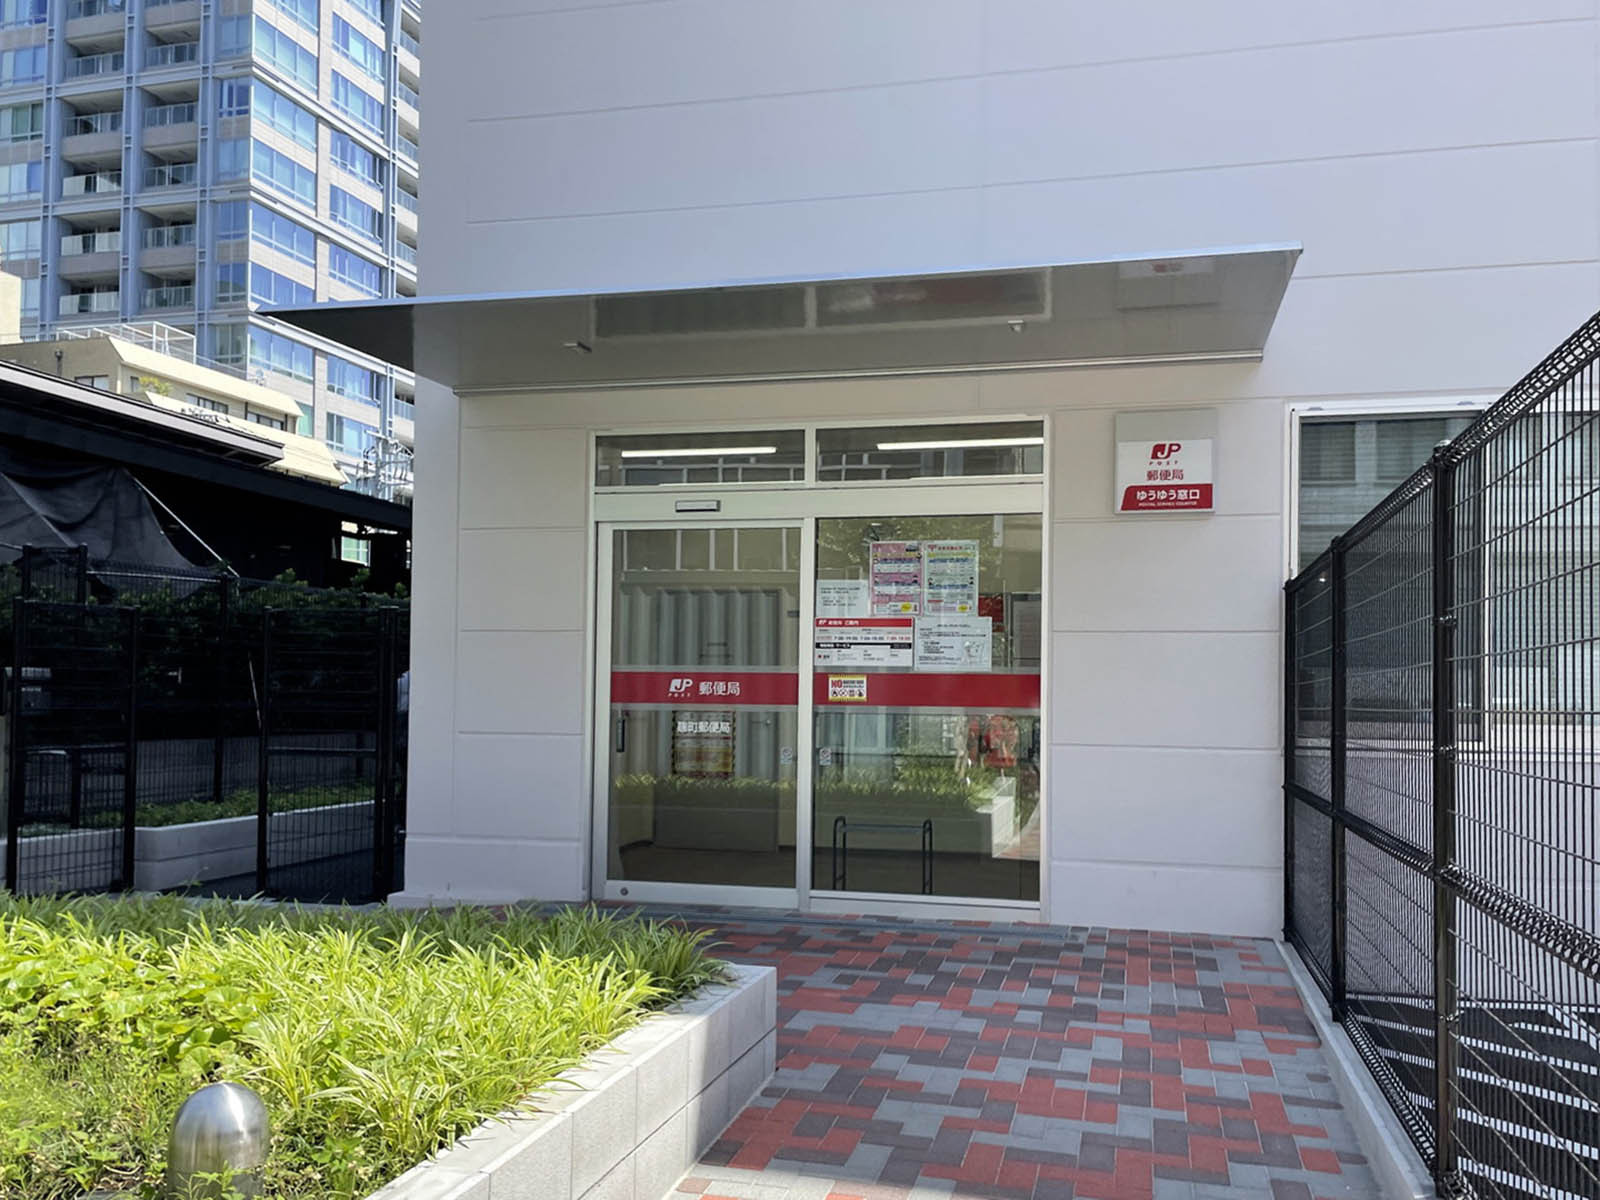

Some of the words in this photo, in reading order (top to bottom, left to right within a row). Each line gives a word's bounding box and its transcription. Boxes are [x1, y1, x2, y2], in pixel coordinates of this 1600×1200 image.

[1151, 443, 1182, 460] JP
[1146, 469, 1184, 481] 郵便局
[1136, 489, 1200, 501] ゆうゆう窓口
[669, 678, 693, 693] JP
[699, 681, 741, 696] 郵便局
